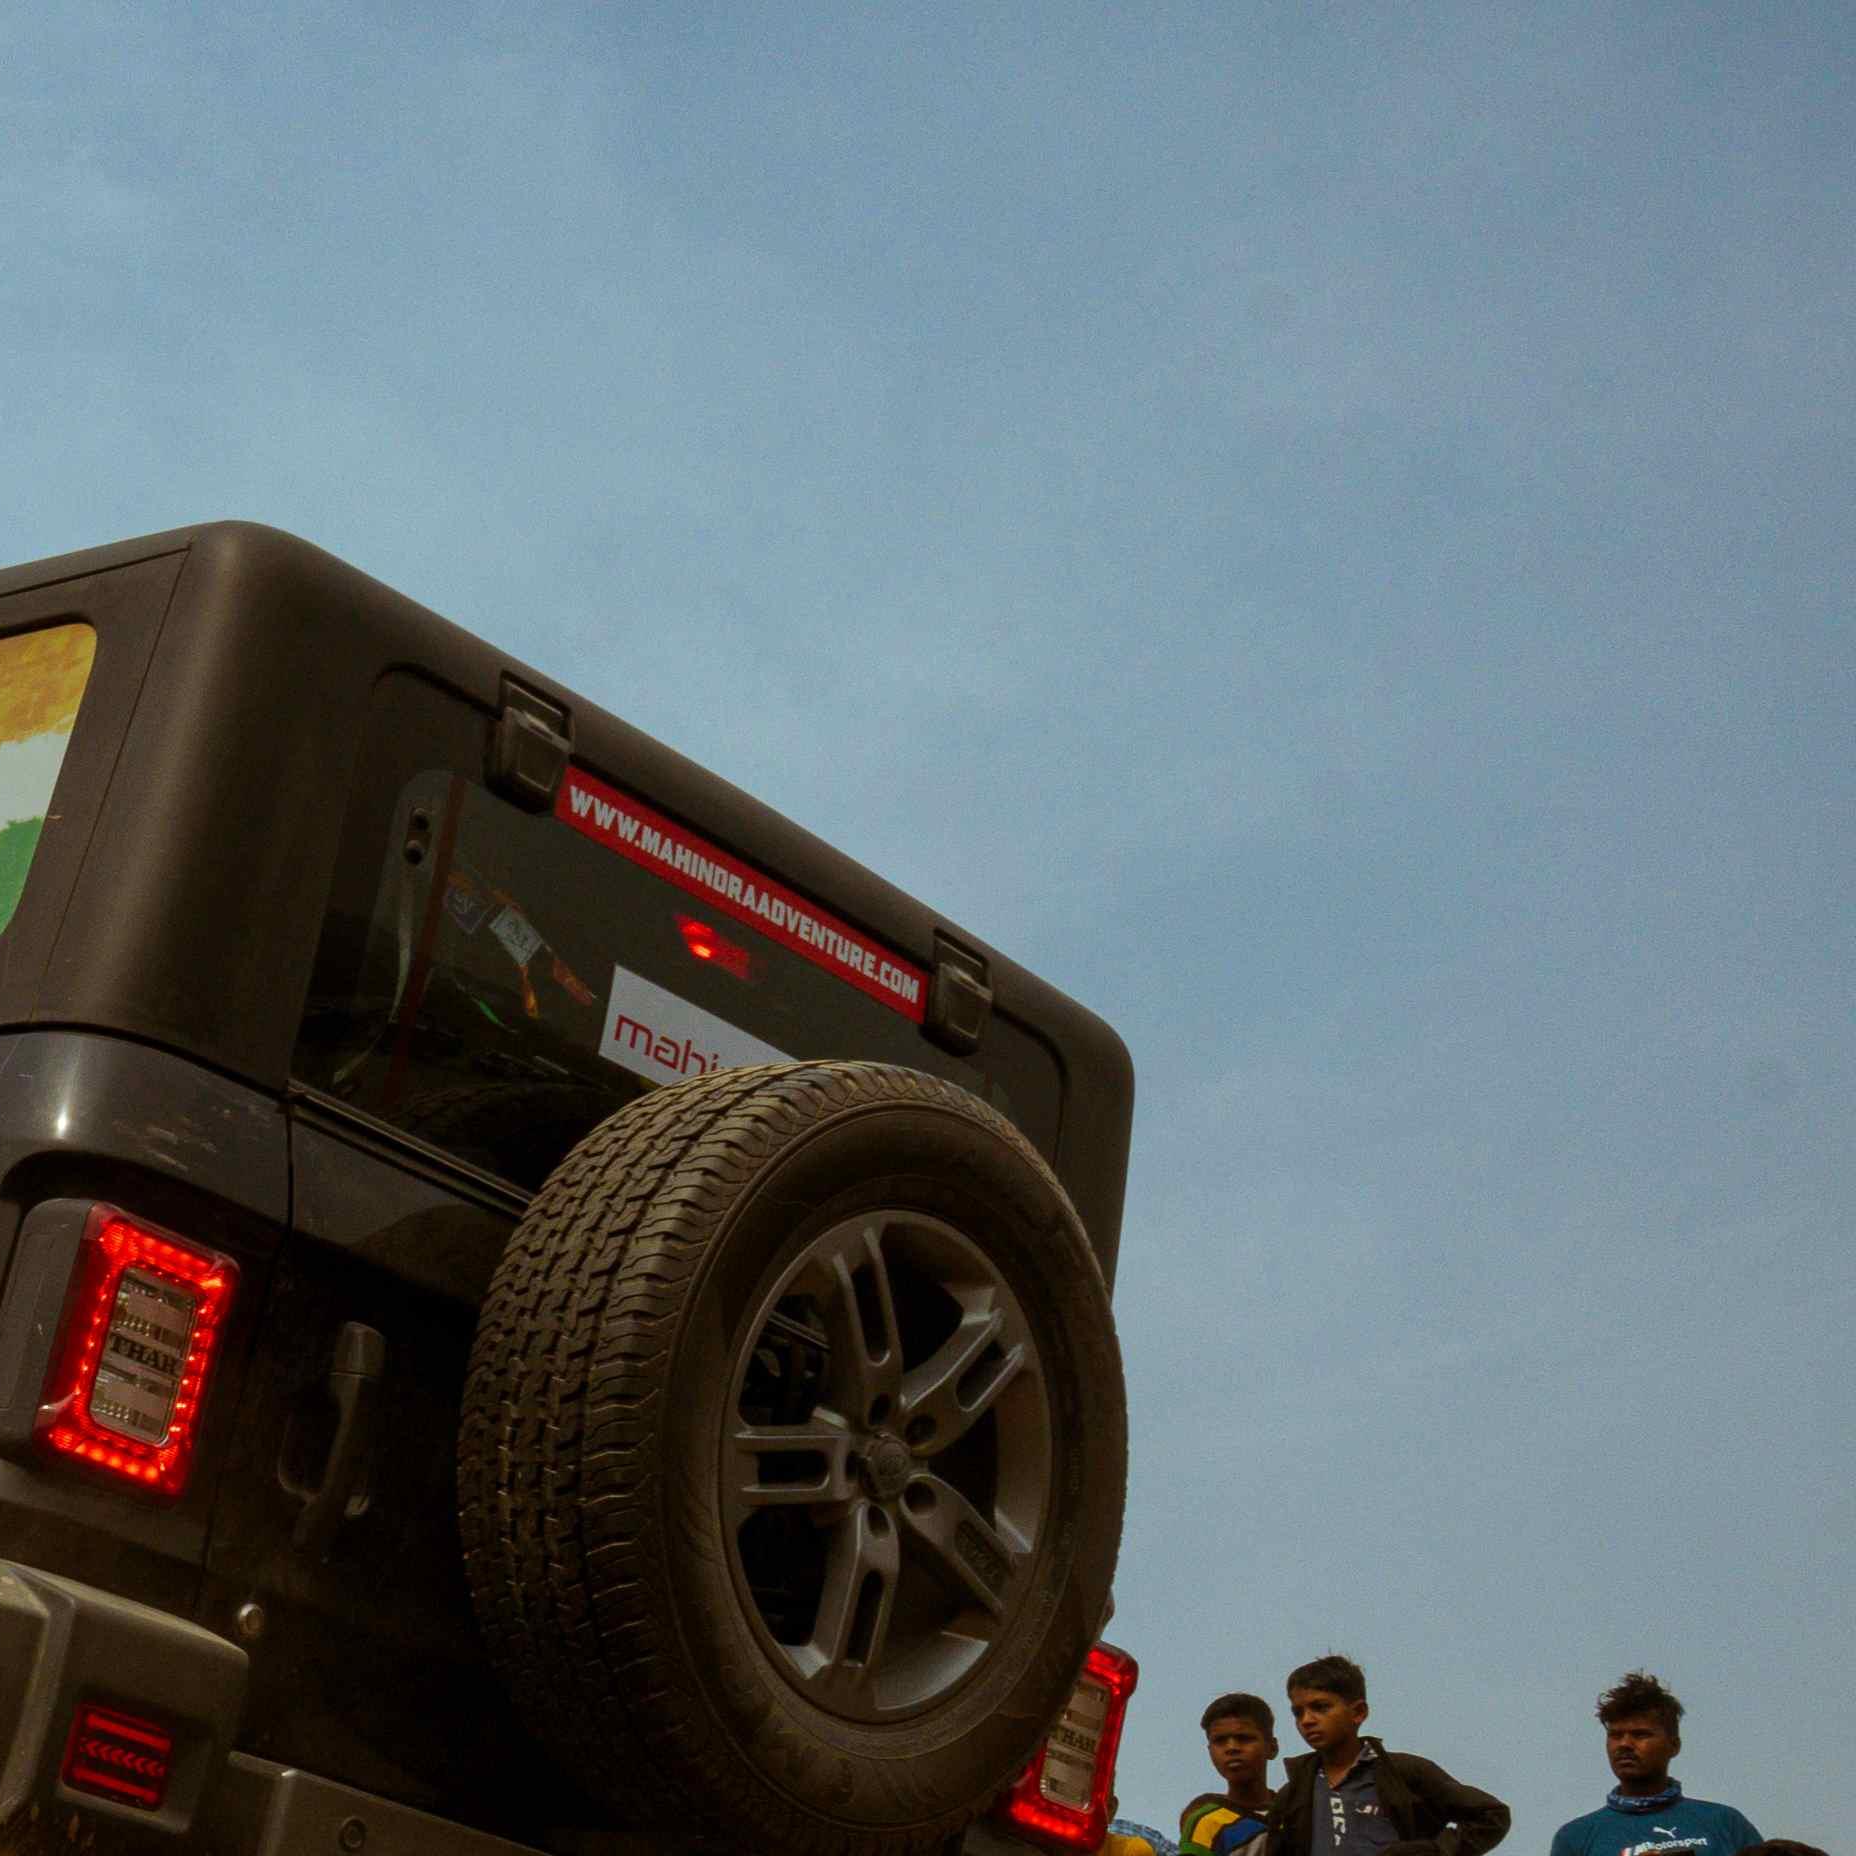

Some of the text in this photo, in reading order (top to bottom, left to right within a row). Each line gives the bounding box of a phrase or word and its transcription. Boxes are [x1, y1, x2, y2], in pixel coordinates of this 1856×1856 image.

[569, 785, 919, 1004] WWW.MAHINDRAADVENTURE.COM
[614, 1014, 719, 1075] mahi
[110, 1330, 177, 1377] THAR
